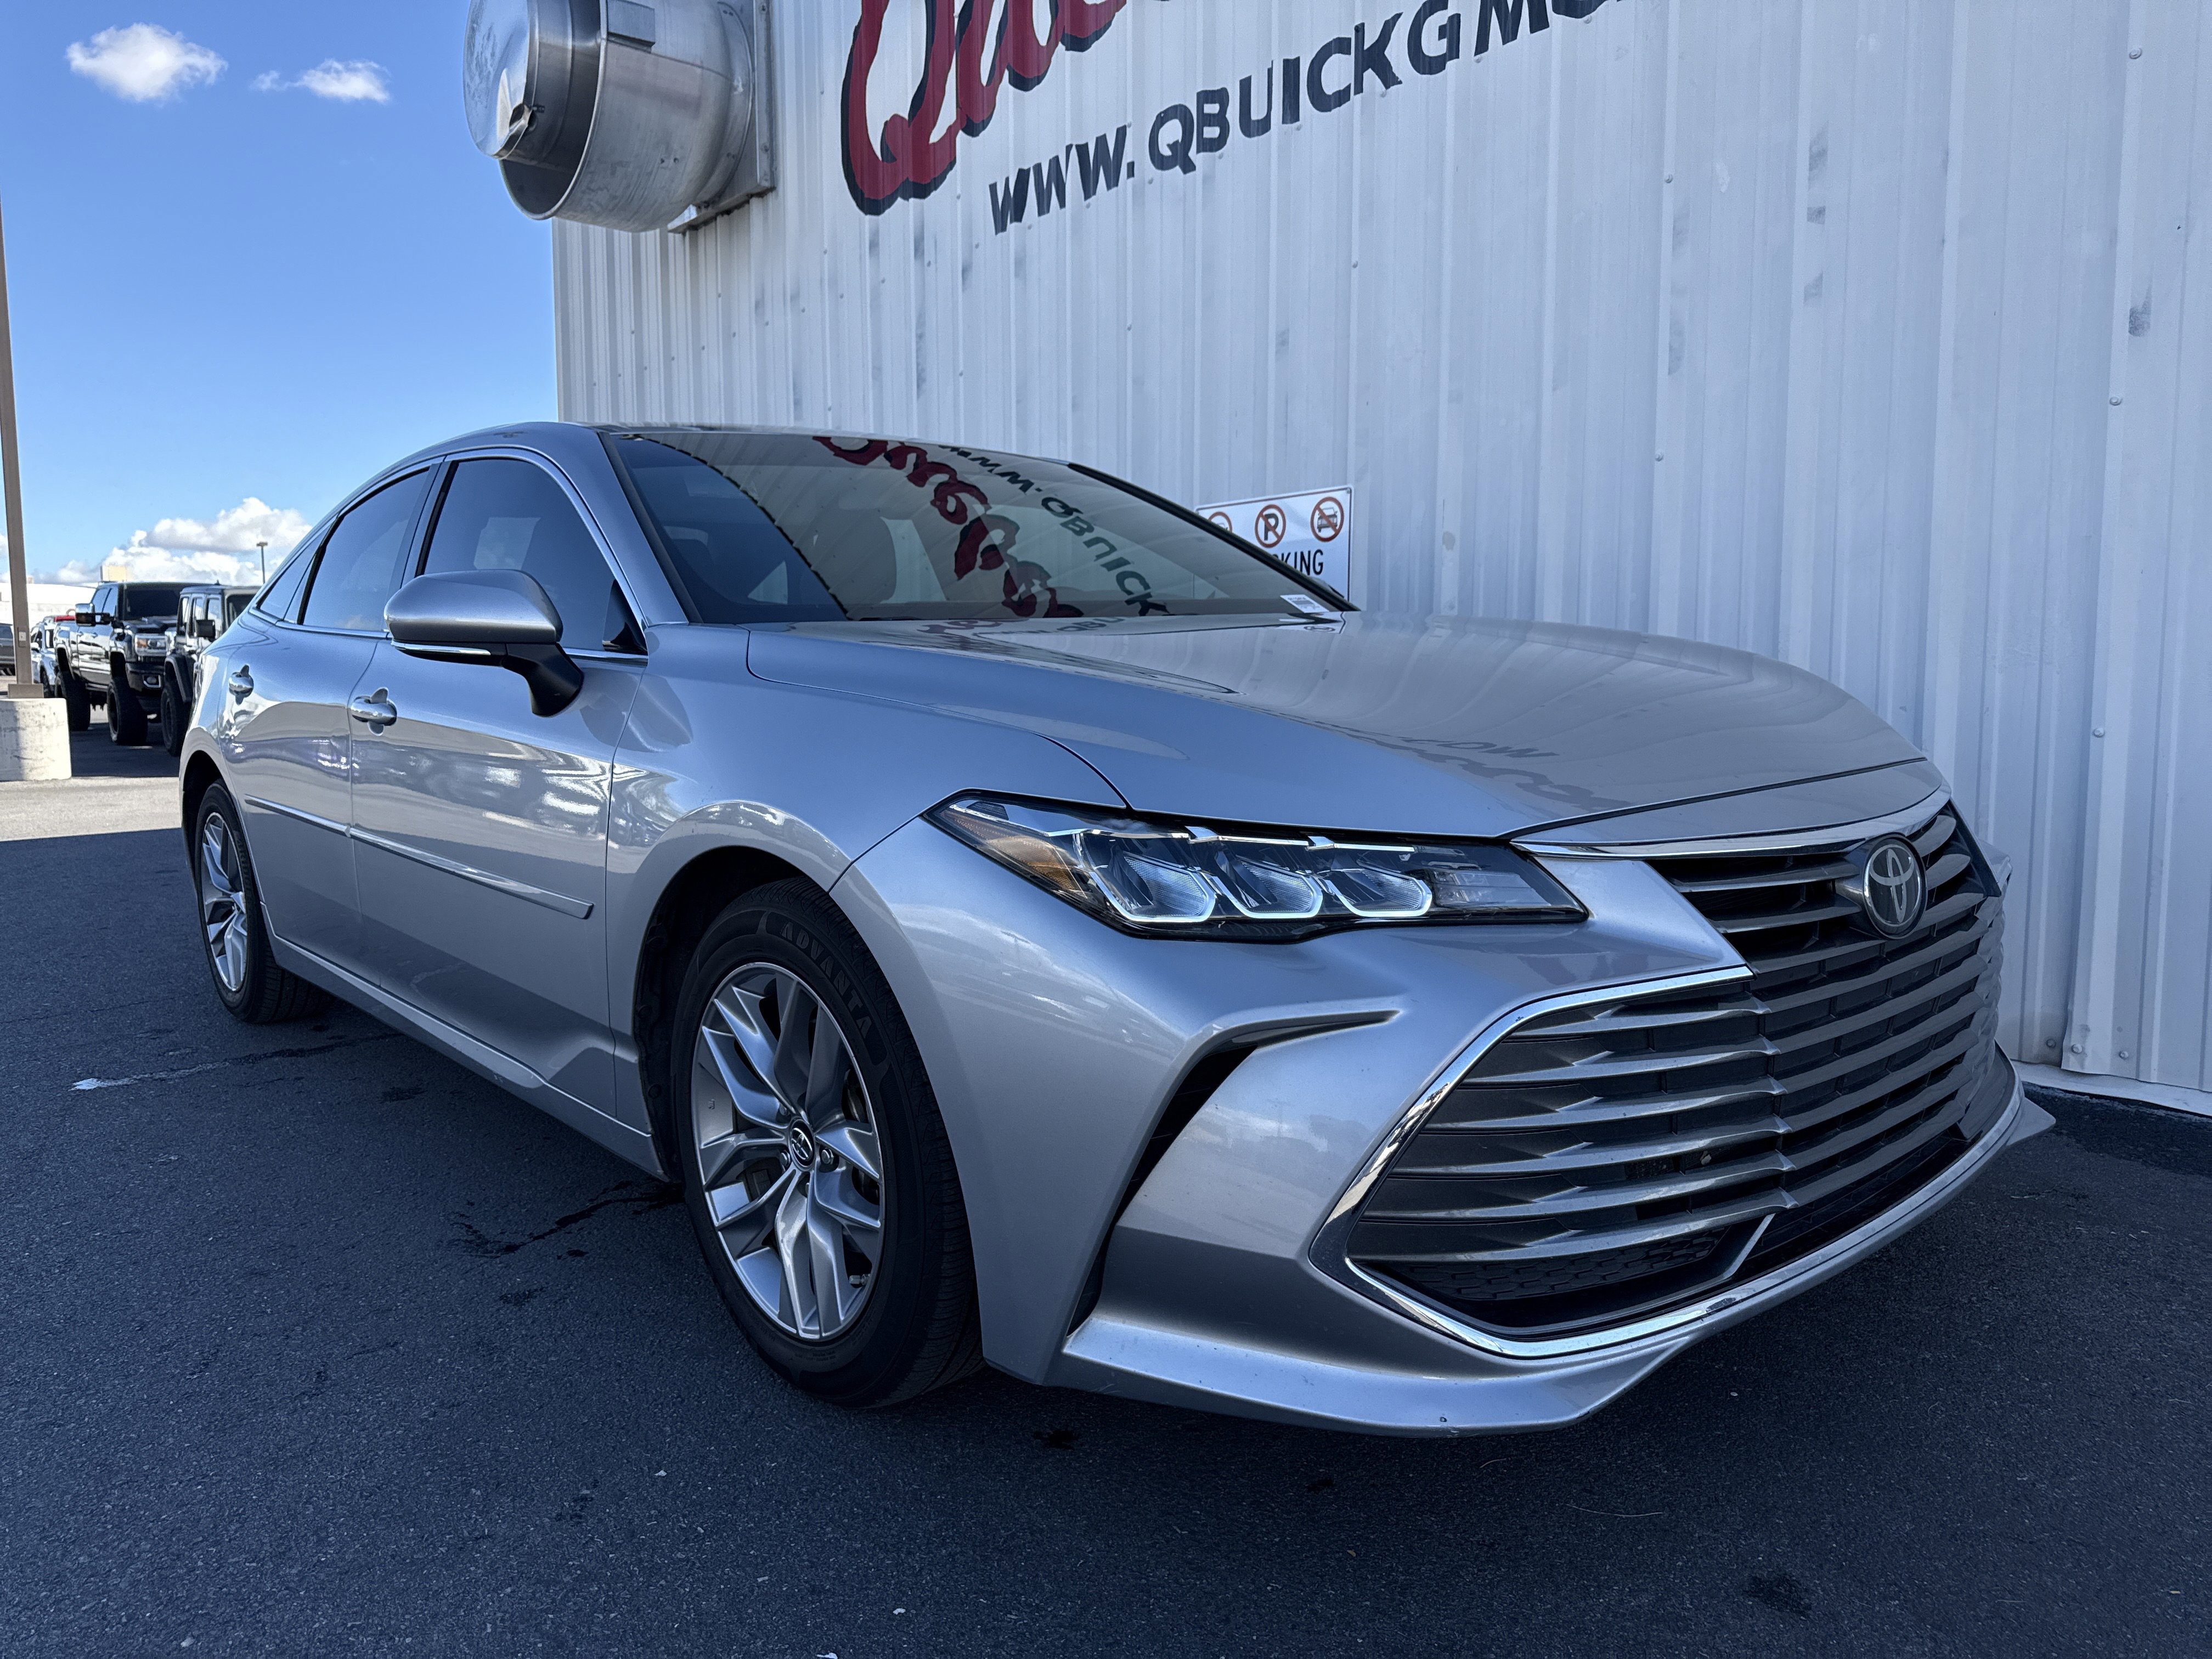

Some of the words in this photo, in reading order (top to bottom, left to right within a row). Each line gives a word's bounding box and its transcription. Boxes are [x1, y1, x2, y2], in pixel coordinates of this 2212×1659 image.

[989, 0, 1610, 235] WWW.QBUICKGM
[1272, 549, 1324, 575] KING
[779, 921, 872, 1039] ADVANTA
